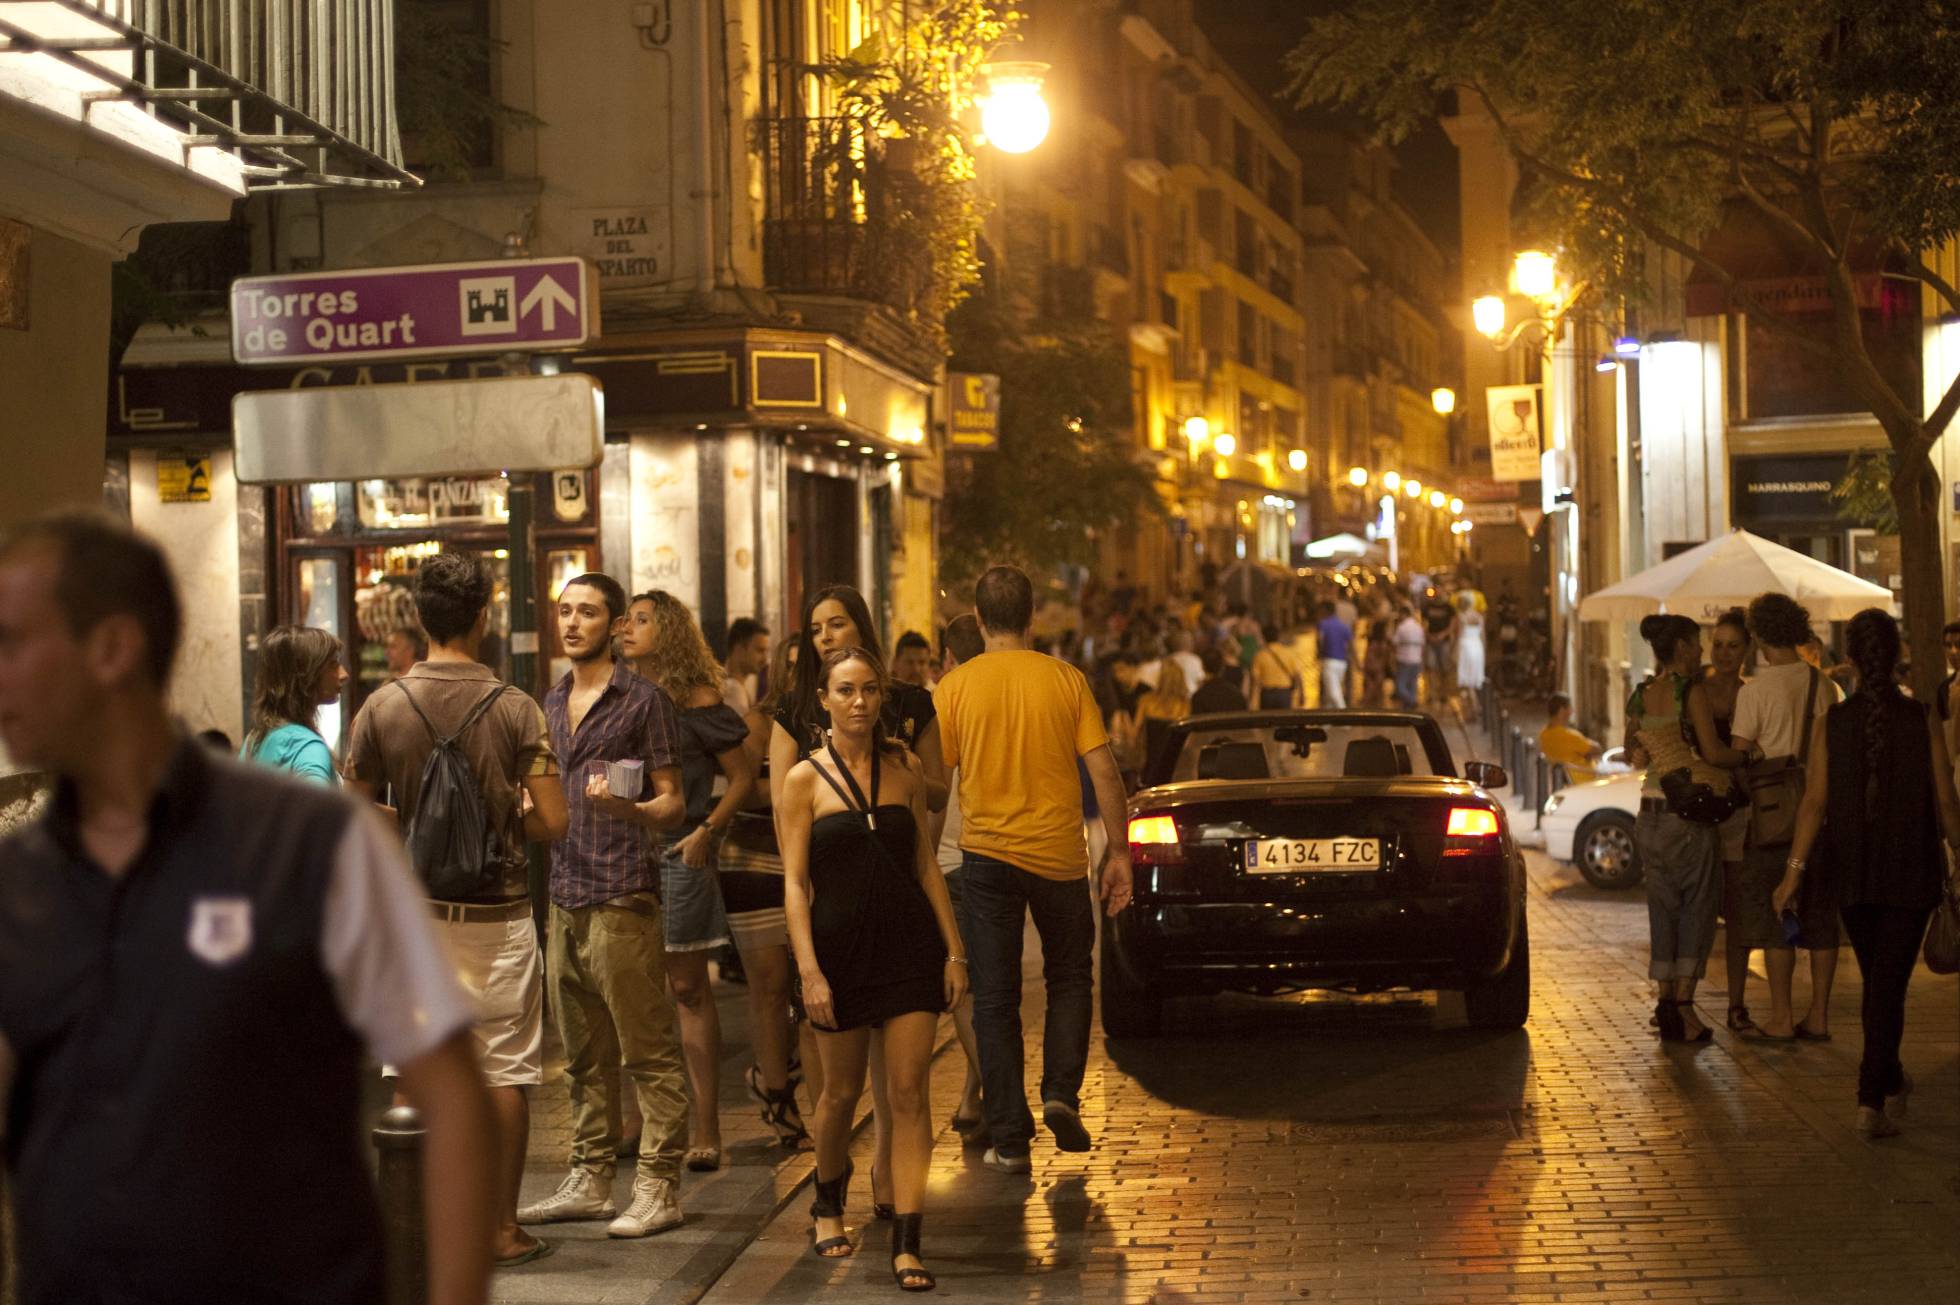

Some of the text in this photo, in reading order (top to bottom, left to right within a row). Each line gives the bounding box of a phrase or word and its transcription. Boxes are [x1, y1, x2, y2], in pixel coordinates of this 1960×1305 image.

[592, 216, 648, 236] PLAZA
[606, 239, 635, 255] DEL
[596, 257, 657, 277] SPARTO
[242, 288, 359, 319] Torres
[244, 313, 416, 351] de Quart
[1747, 480, 1832, 494] MARRASQUINO
[1265, 842, 1374, 864] 4134 FZC
